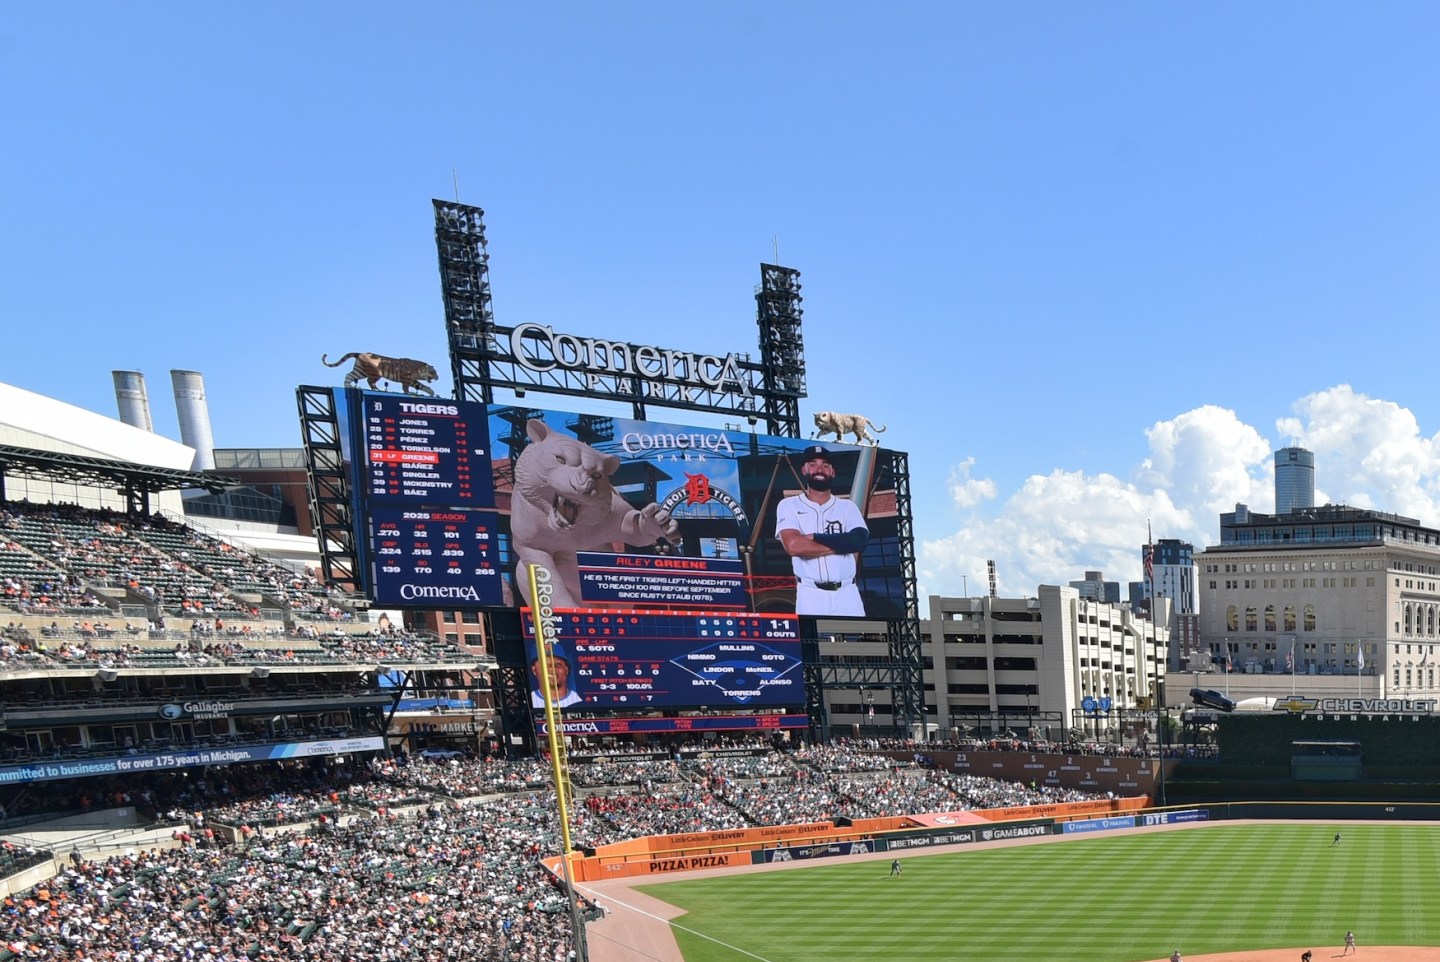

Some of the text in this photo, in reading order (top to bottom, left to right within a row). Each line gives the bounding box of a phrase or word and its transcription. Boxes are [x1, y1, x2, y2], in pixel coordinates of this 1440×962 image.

[587, 373, 695, 403] PARK
[399, 403, 458, 415] TIGERS
[400, 435, 428, 443] PÉREZ
[401, 445, 450, 453] TORKELSON
[657, 454, 706, 462] PARK
[713, 490, 745, 522] TIGERS
[616, 558, 707, 569] RILEY GREENE
[538, 583, 559, 644] Rocket
[771, 620, 789, 629] 1-1
[184, 701, 234, 713] Gallagher
[1322, 698, 1437, 712] CHEVROLET
[194, 712, 228, 720] INSURANCE
[441, 722, 478, 732] MARKET
[47, 767, 58, 777] to
[61, 762, 115, 776] businesses
[117, 759, 131, 770] for
[134, 759, 153, 769] over
[156, 756, 174, 766] 175
[176, 756, 199, 768] years
[201, 753, 209, 762] in
[211, 750, 250, 764] Michigan.
[1146, 814, 1168, 825] DTE
[799, 825, 828, 833] DELIVERY
[994, 827, 1045, 838] GAMEABOVE
[712, 832, 744, 841] DELIVERY
[650, 856, 728, 872] PIZZA! PIZZA!
